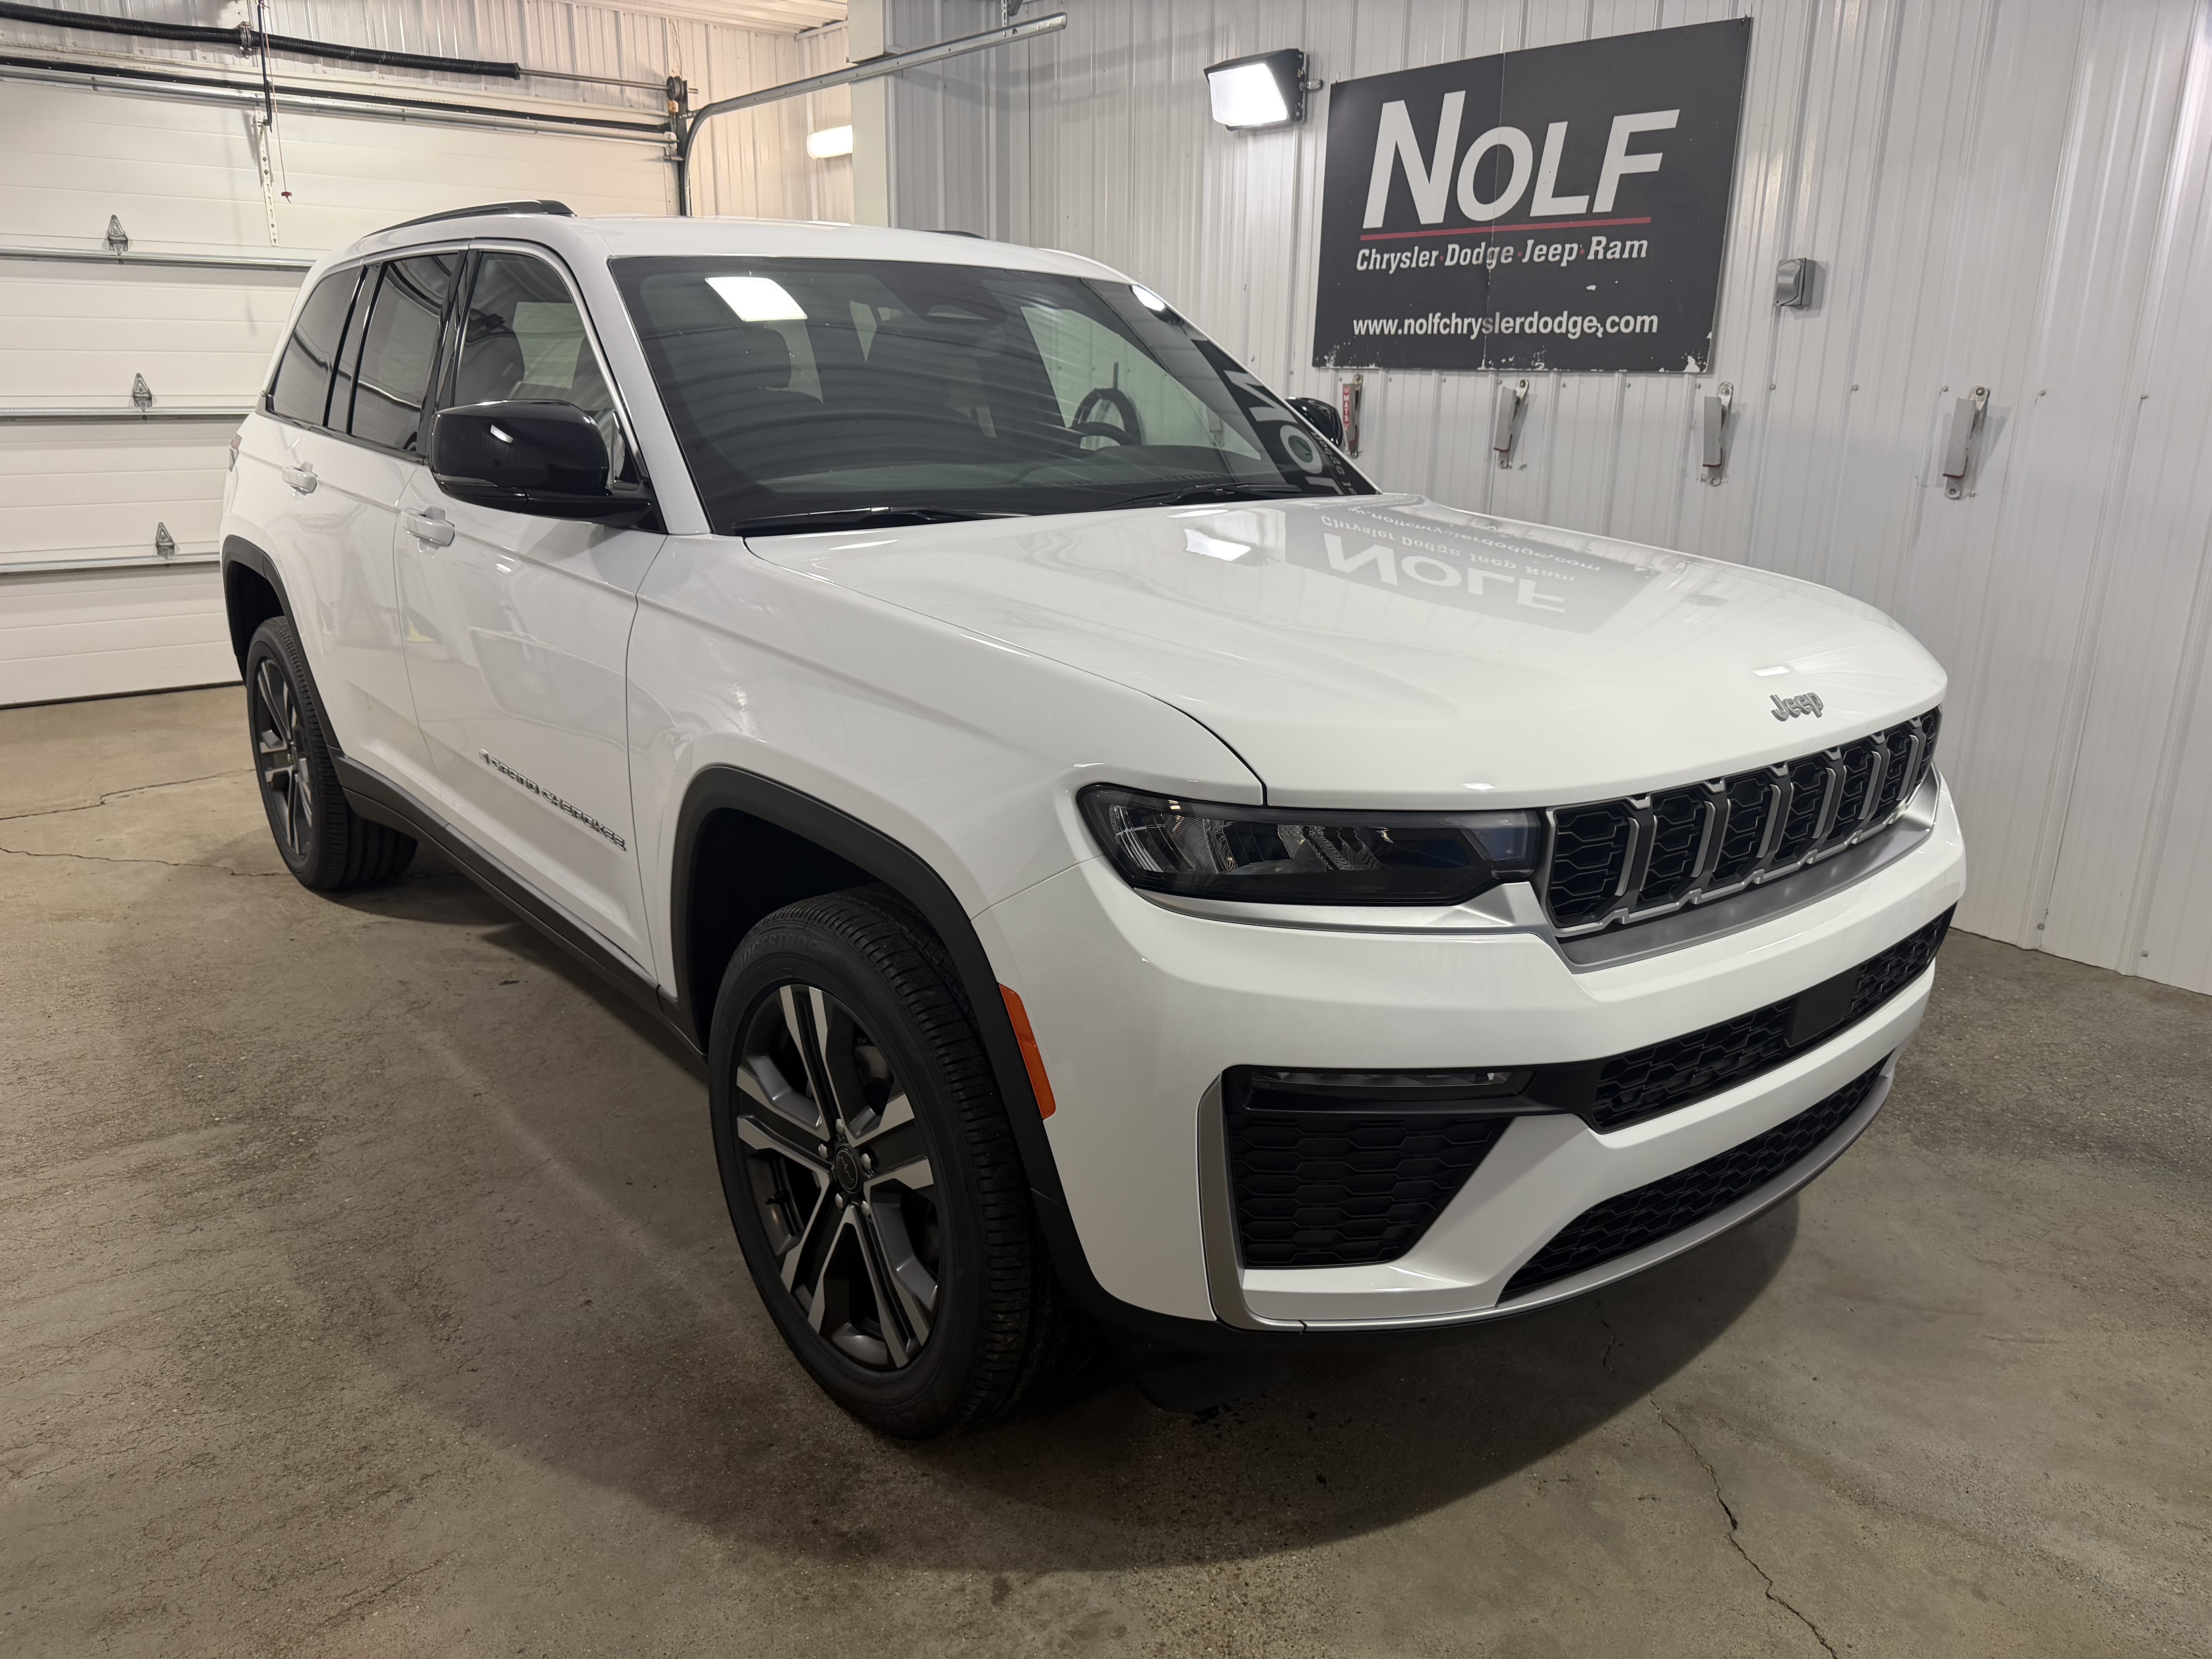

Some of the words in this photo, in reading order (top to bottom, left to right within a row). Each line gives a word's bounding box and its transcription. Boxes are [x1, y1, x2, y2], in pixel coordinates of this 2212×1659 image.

[1362, 90, 1680, 229] NOLF
[1356, 246, 1439, 274] Chrysler
[1444, 242, 1514, 270] Dodge
[1522, 239, 1578, 267] Jeep
[1587, 236, 1648, 260] Ram
[1769, 692, 1824, 722] Jeep
[542, 788, 627, 851] CHEROKEE
